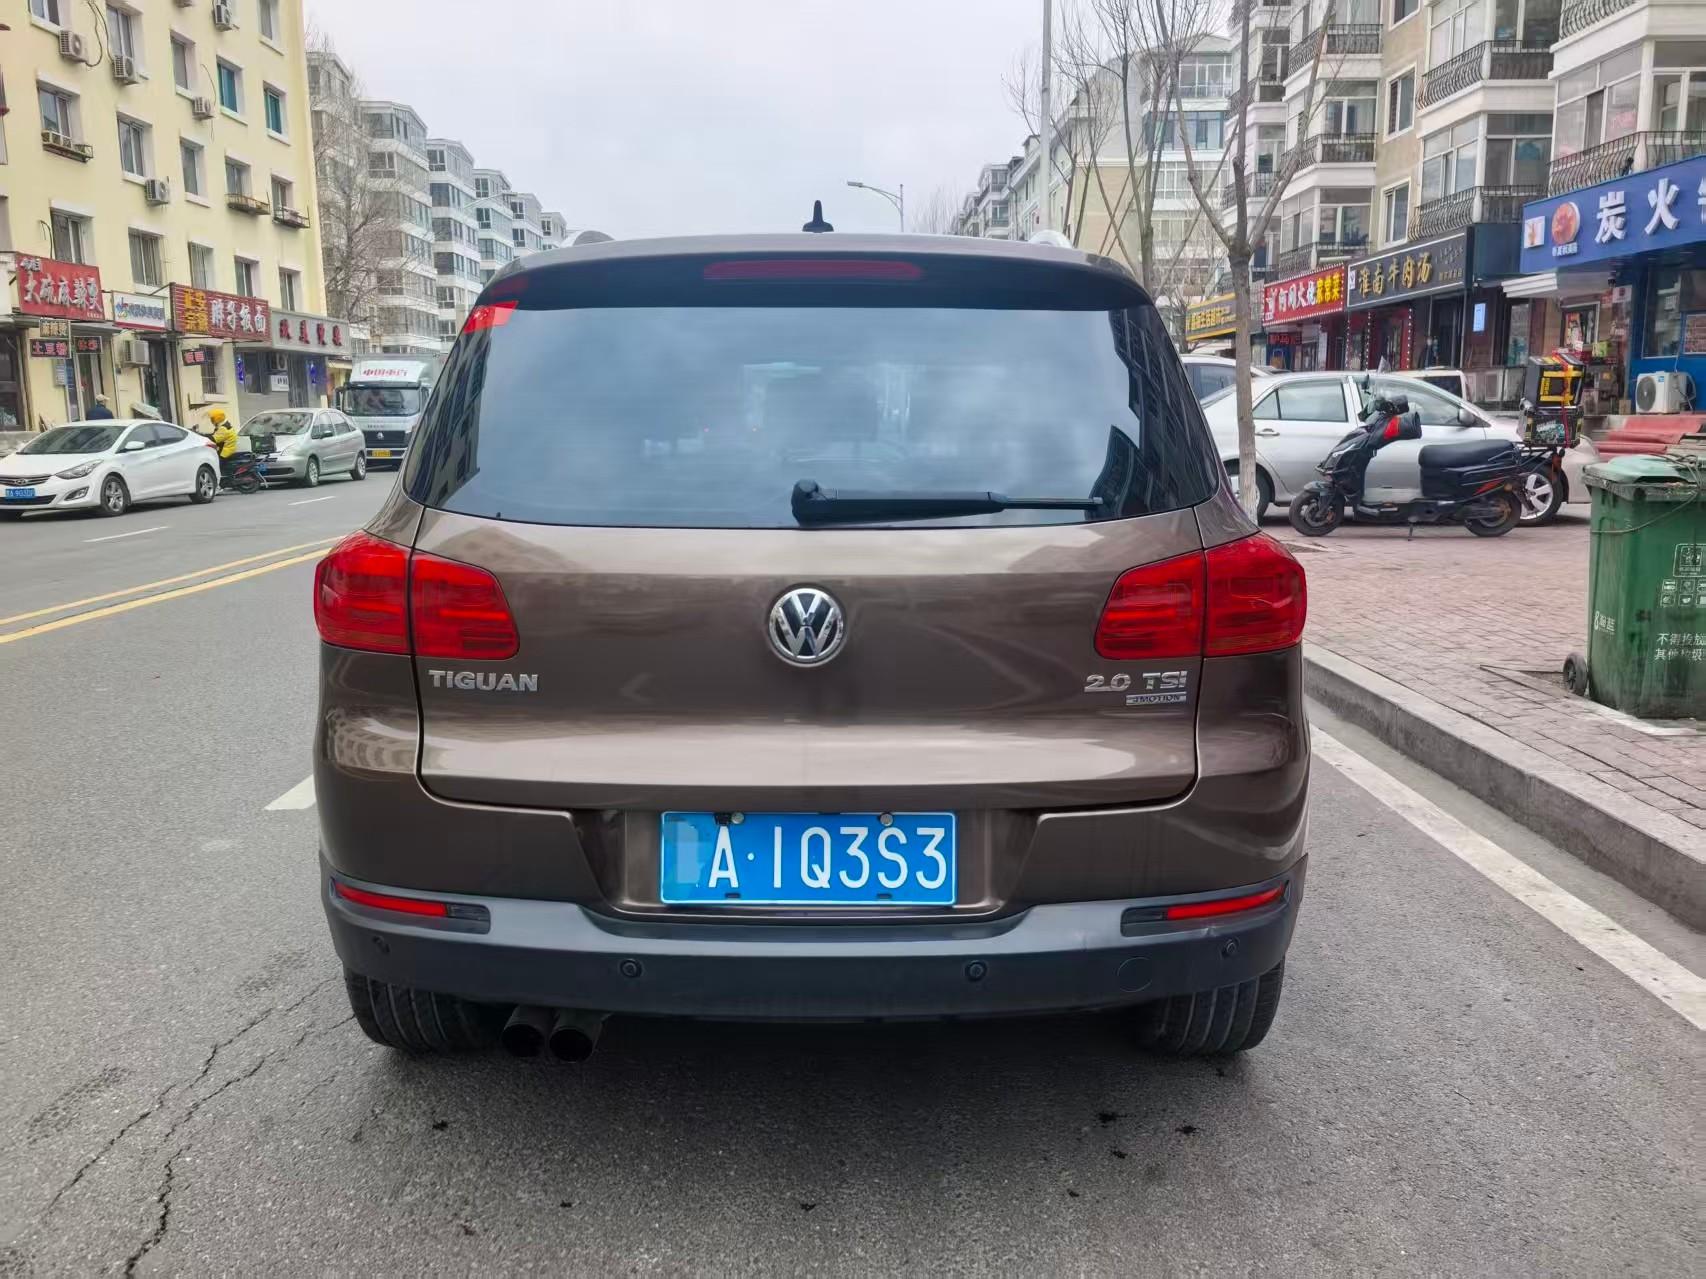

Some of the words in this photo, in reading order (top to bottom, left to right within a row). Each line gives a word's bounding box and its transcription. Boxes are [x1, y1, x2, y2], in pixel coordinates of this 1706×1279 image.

[1594, 177, 1706, 243] 炭火
[1359, 251, 1434, 299] 淮南牛肉汤
[428, 669, 539, 692] TIGUAN
[1083, 673, 1131, 693] 2.0
[676, 825, 948, 889] A·1Q3S3
